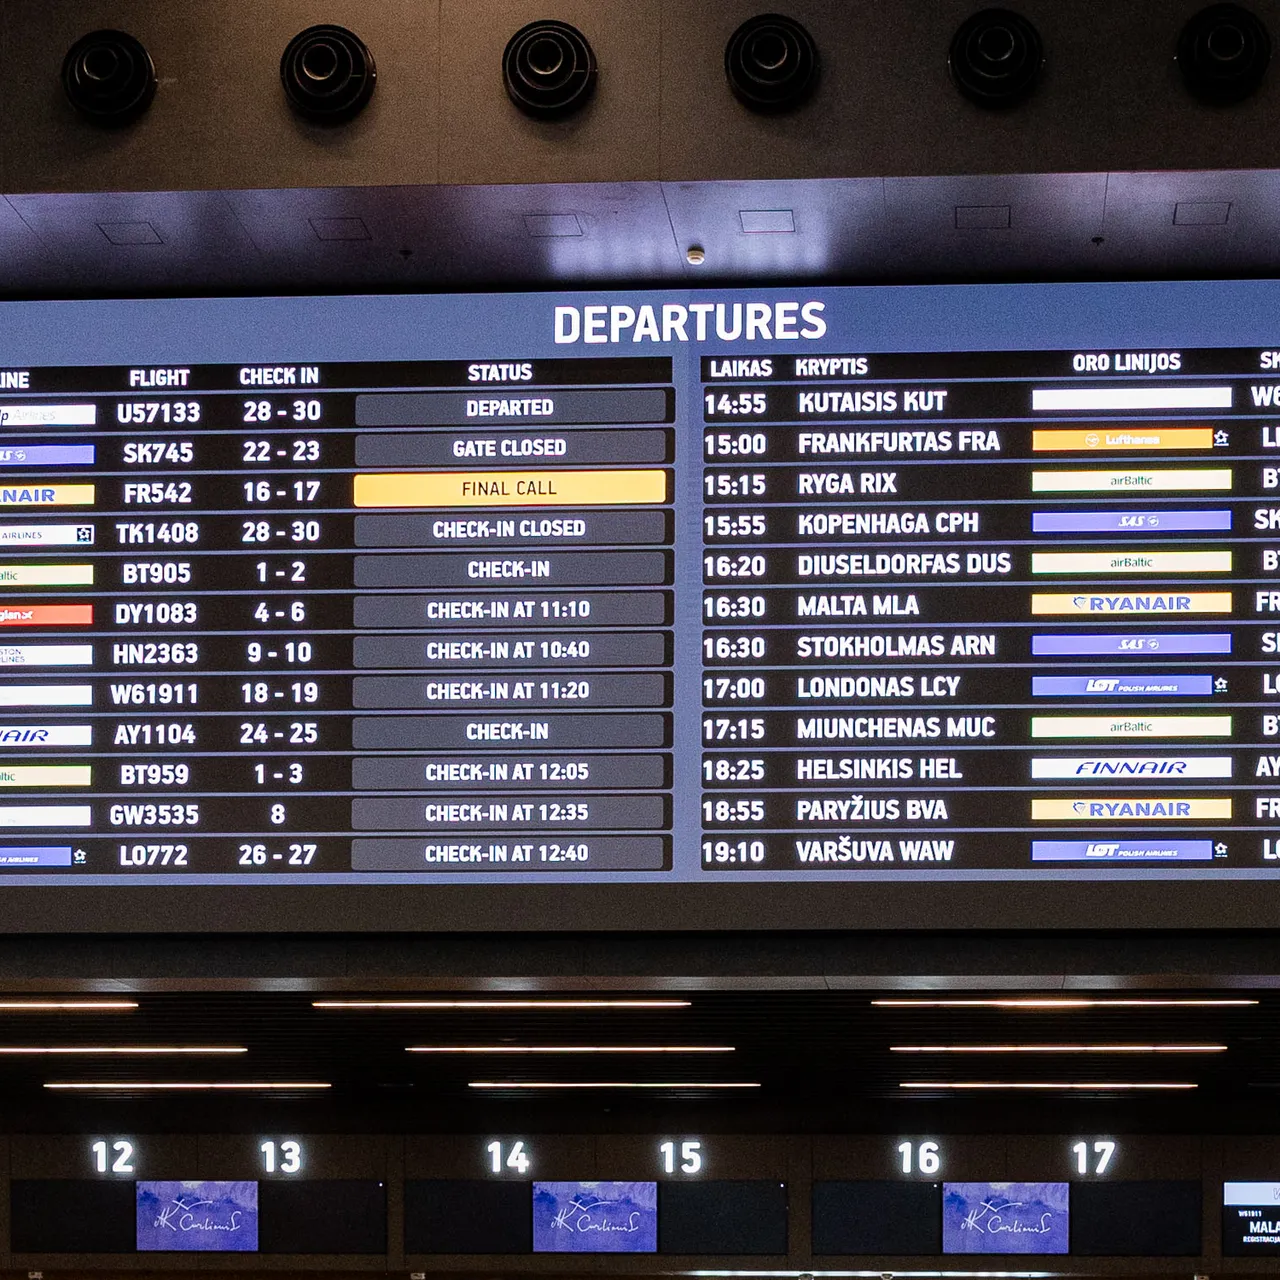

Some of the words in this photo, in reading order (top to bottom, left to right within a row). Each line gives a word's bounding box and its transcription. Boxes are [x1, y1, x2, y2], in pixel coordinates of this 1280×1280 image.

[555, 302, 826, 343] DEPARTURES
[468, 364, 532, 381] STATUS
[711, 359, 772, 377] LAIKAS
[796, 358, 868, 376] KRYPTIS
[1073, 354, 1110, 371] ORO
[1115, 353, 1181, 373] LINIJOS
[130, 369, 190, 386] FLIGHT
[240, 368, 296, 384] CHECK
[301, 367, 318, 383] IN
[467, 399, 553, 416] DEPARTED
[705, 394, 766, 414] 14:55
[800, 391, 897, 412] KUTAISIS
[904, 391, 947, 411] KUT
[118, 402, 200, 423] U57133
[453, 440, 496, 457] GATE
[501, 439, 566, 456] CLOSED
[799, 431, 952, 453] FRANKFURTAS
[959, 431, 1000, 451] FRA
[125, 483, 191, 503] FR542
[463, 482, 507, 495] FINAL
[517, 481, 556, 494] CALL
[799, 473, 854, 494] RYGA
[861, 473, 897, 493] RIX
[799, 513, 930, 534] KOPENHAGA
[936, 512, 978, 532] CPH
[799, 553, 960, 575] DIUSELDORFAS
[967, 553, 1011, 573] DUS
[798, 595, 867, 616] MALTA
[873, 595, 919, 615] MLA
[797, 635, 945, 657] STOKHOLMAS
[950, 635, 995, 655] ARN
[798, 676, 914, 697] LONDONAS
[921, 676, 960, 696] LCY
[797, 717, 940, 738] MIUNCHENAS
[947, 717, 995, 737] MUC
[798, 758, 913, 779] HELSINKIS
[920, 758, 962, 778] HEL
[1076, 762, 1187, 774] FINNAIR
[797, 795, 900, 820] PARYŽIUS
[907, 800, 948, 819] BVA
[703, 841, 764, 862] 19:10
[796, 836, 894, 862] VARŠUVA
[899, 841, 954, 861] WAW
[92, 1140, 134, 1173] 12
[261, 1140, 301, 1173] 13
[487, 1141, 530, 1173] 14
[660, 1141, 702, 1174] 15
[898, 1141, 940, 1174] 16
[1072, 1141, 1116, 1174] 17
